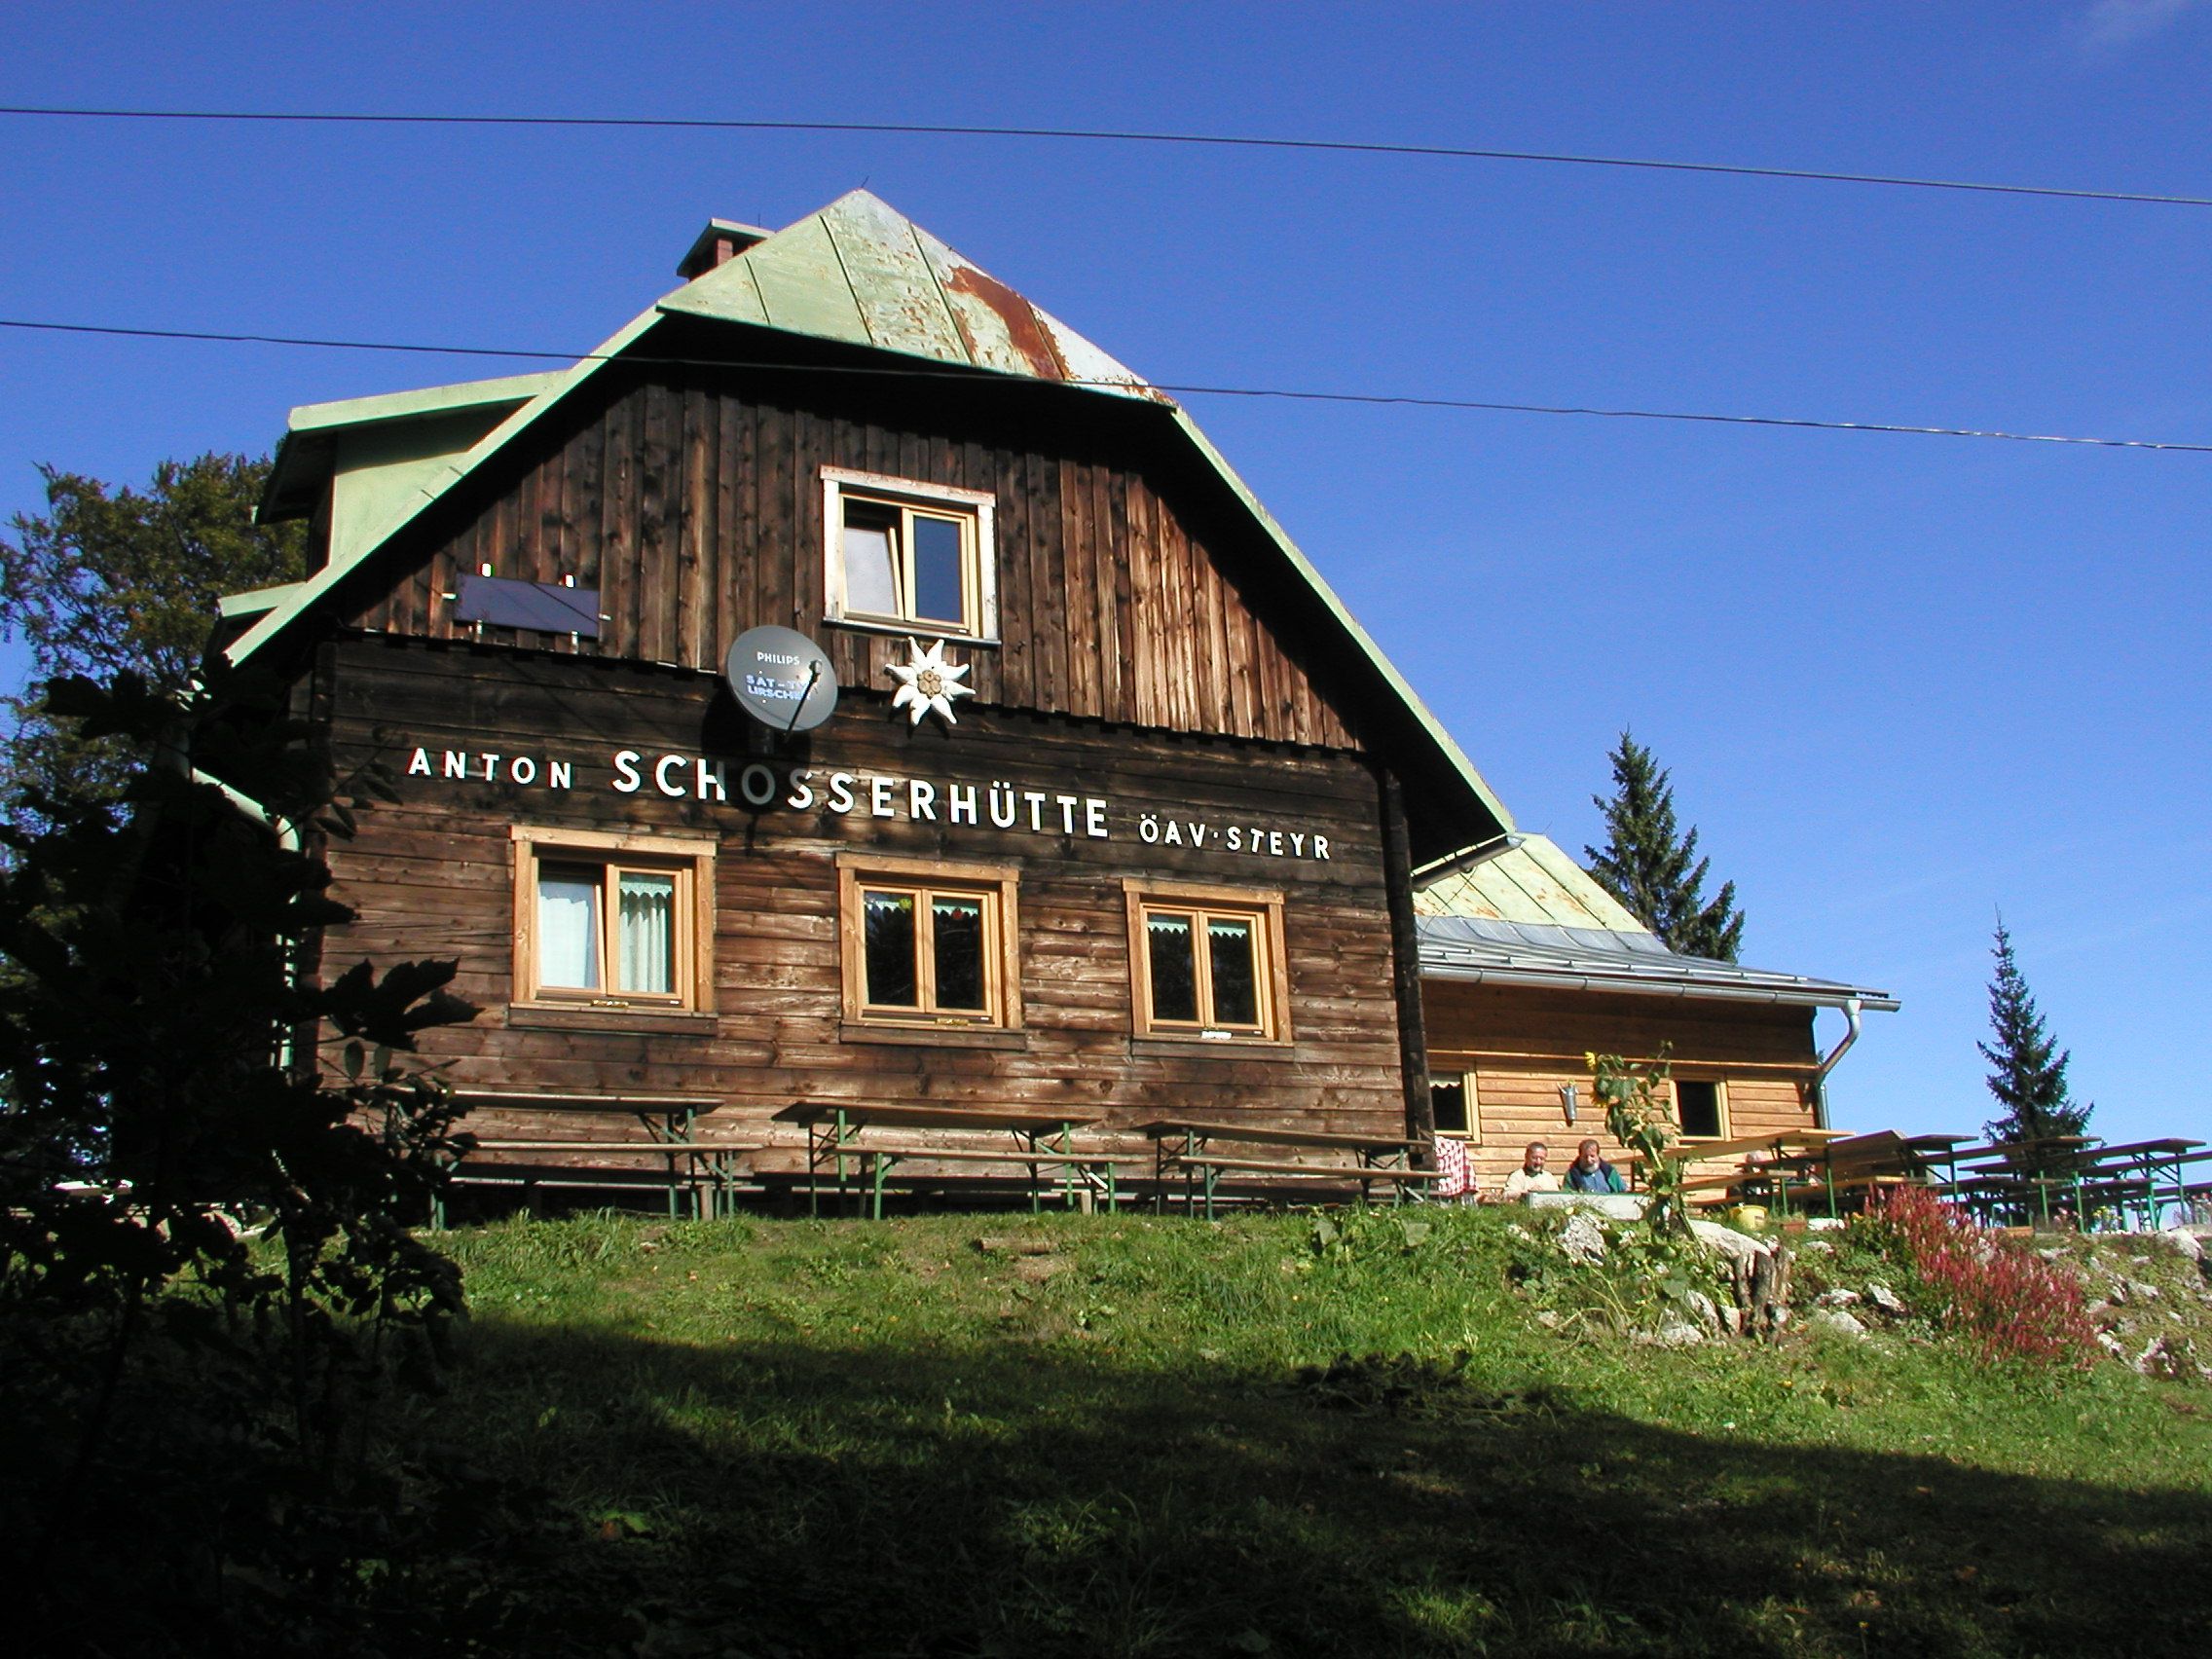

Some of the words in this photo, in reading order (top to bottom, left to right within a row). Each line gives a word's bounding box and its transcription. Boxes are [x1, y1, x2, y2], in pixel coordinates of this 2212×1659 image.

[756, 650, 800, 666] PHILIPS
[408, 747, 571, 789] ANTON
[611, 750, 1108, 838] SCHOSSERHÜTTE
